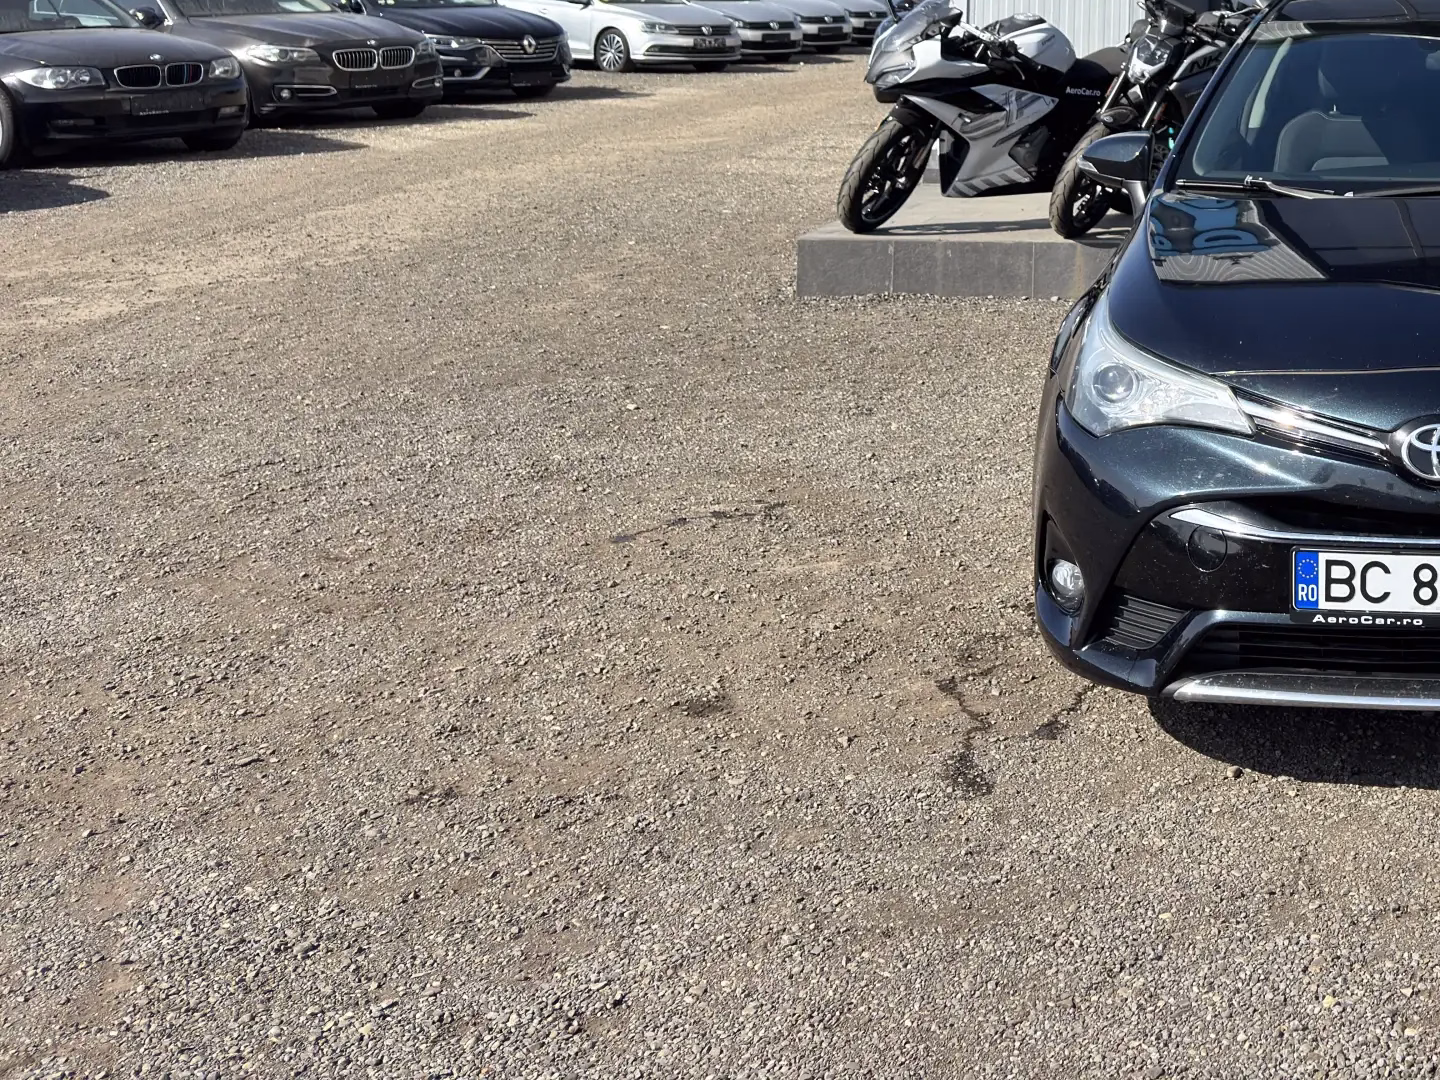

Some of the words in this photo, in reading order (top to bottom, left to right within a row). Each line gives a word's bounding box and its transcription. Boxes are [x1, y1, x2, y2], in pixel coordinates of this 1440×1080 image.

[1066, 86, 1101, 96] AeroCar.ro
[1325, 559, 1391, 604] BC
[1298, 584, 1318, 601] RO
[1312, 614, 1424, 626] AeroCar.ro
